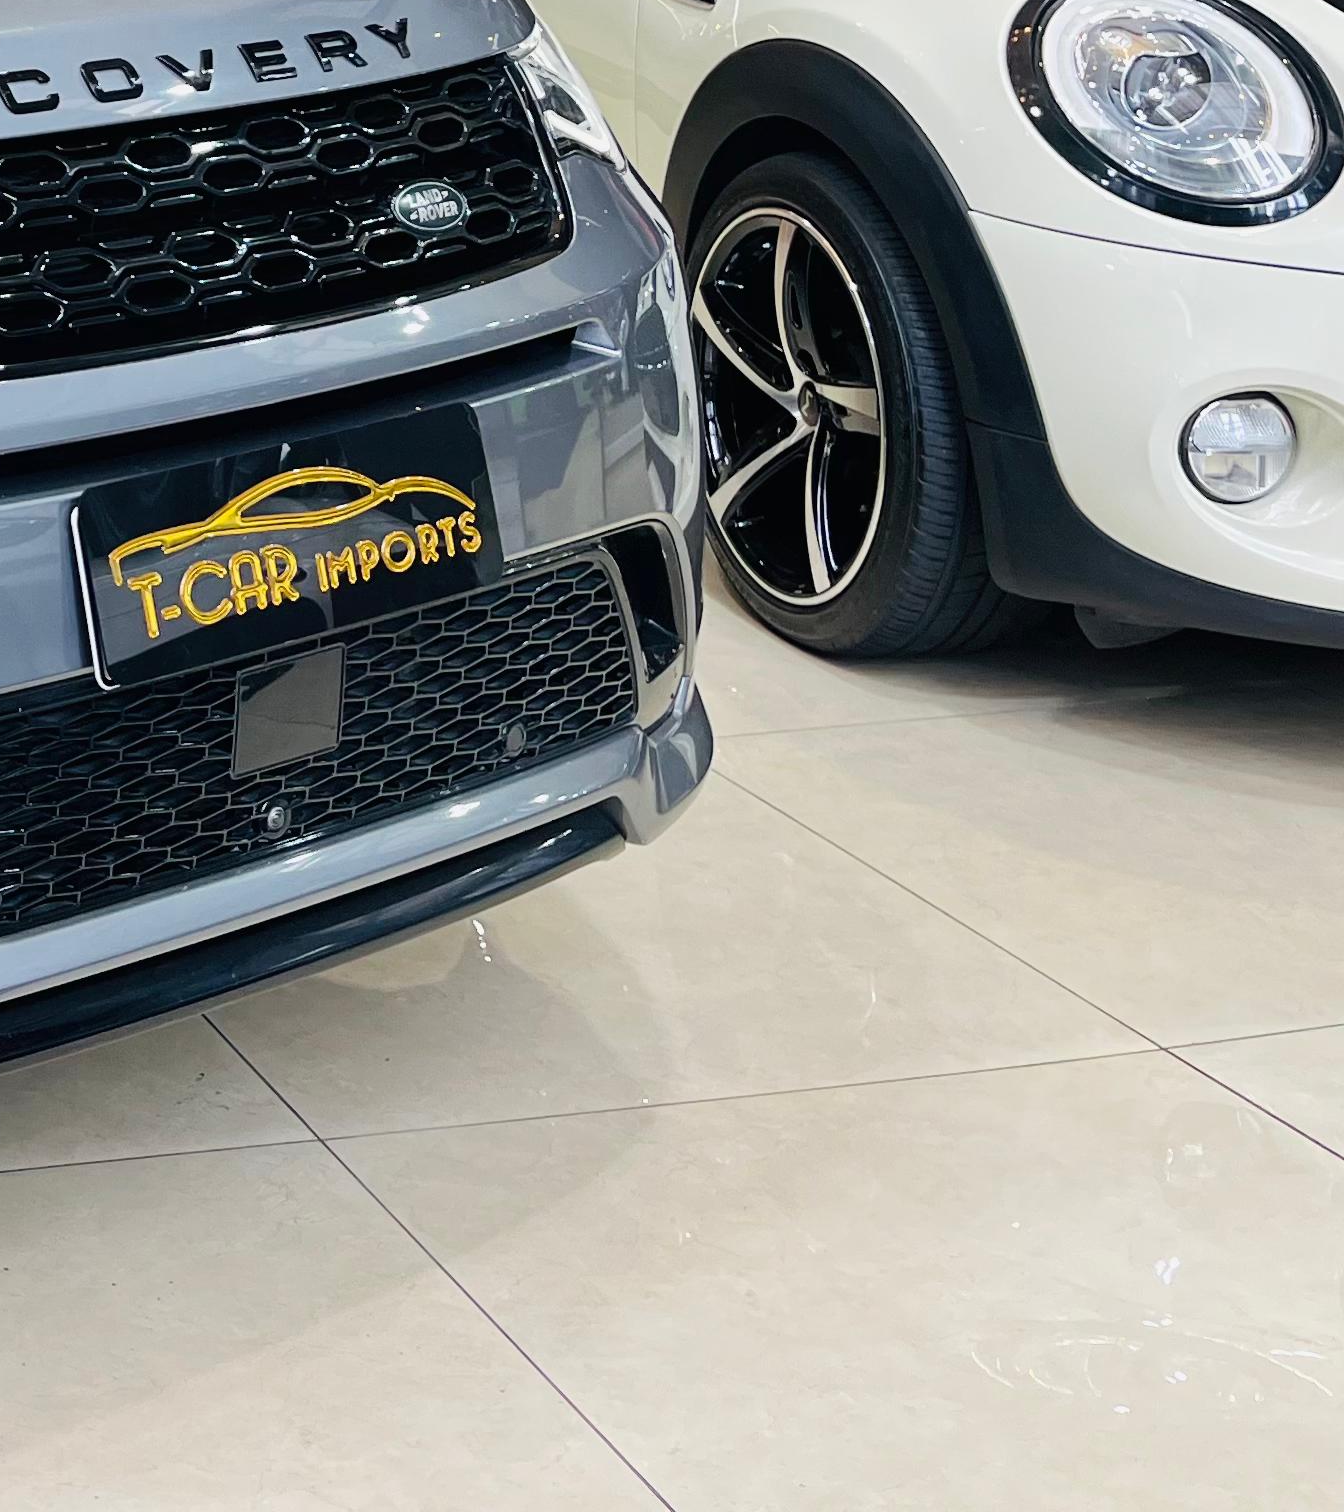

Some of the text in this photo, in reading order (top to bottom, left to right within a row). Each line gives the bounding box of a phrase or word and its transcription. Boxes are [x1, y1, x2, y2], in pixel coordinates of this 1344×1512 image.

[408, 188, 445, 208] LAND
[417, 200, 459, 223] ROVER
[127, 512, 482, 639] T-CAR IMPORTS
